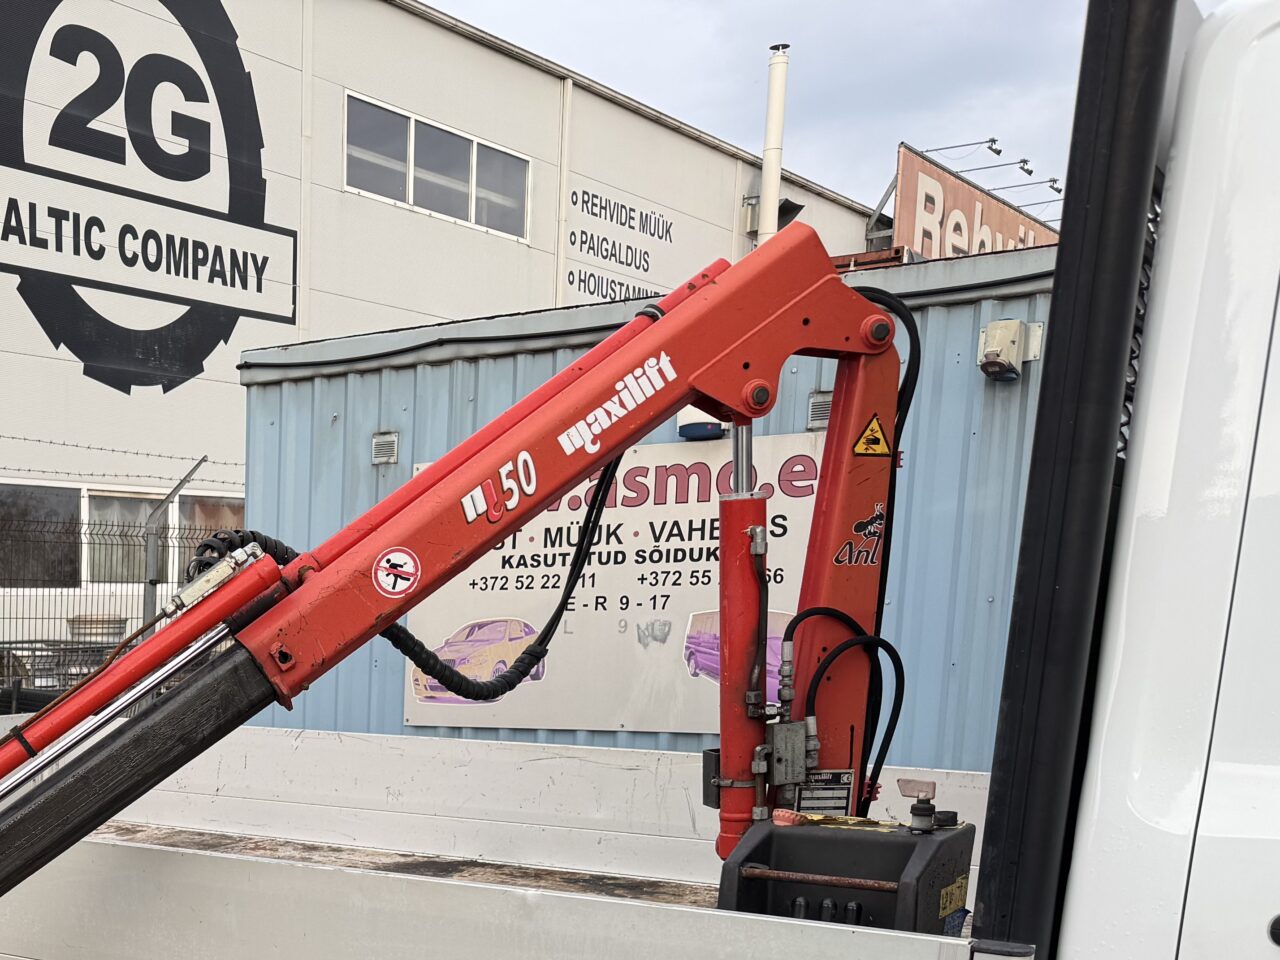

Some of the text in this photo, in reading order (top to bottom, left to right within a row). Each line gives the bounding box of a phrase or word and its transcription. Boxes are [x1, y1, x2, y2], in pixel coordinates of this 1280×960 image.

[48, 23, 211, 182] 2G
[581, 190, 673, 244] REHVIDE MÜÜK
[913, 171, 1035, 259] Reh
[119, 223, 269, 294] COMPANY
[579, 229, 650, 273] PAIGALDUS
[578, 269, 660, 301] HOIUSTAMI
[556, 350, 678, 456] maxilift
[648, 514, 788, 543] VAHES
[501, 550, 627, 569] KASUTTUD
[637, 571, 687, 587] +372
[689, 570, 711, 586] 55
[468, 576, 509, 592] +372
[514, 575, 535, 591] 52
[540, 574, 561, 589] 22
[564, 597, 576, 611] E
[594, 596, 608, 610] R
[619, 596, 629, 610] 9
[649, 594, 671, 610] 17
